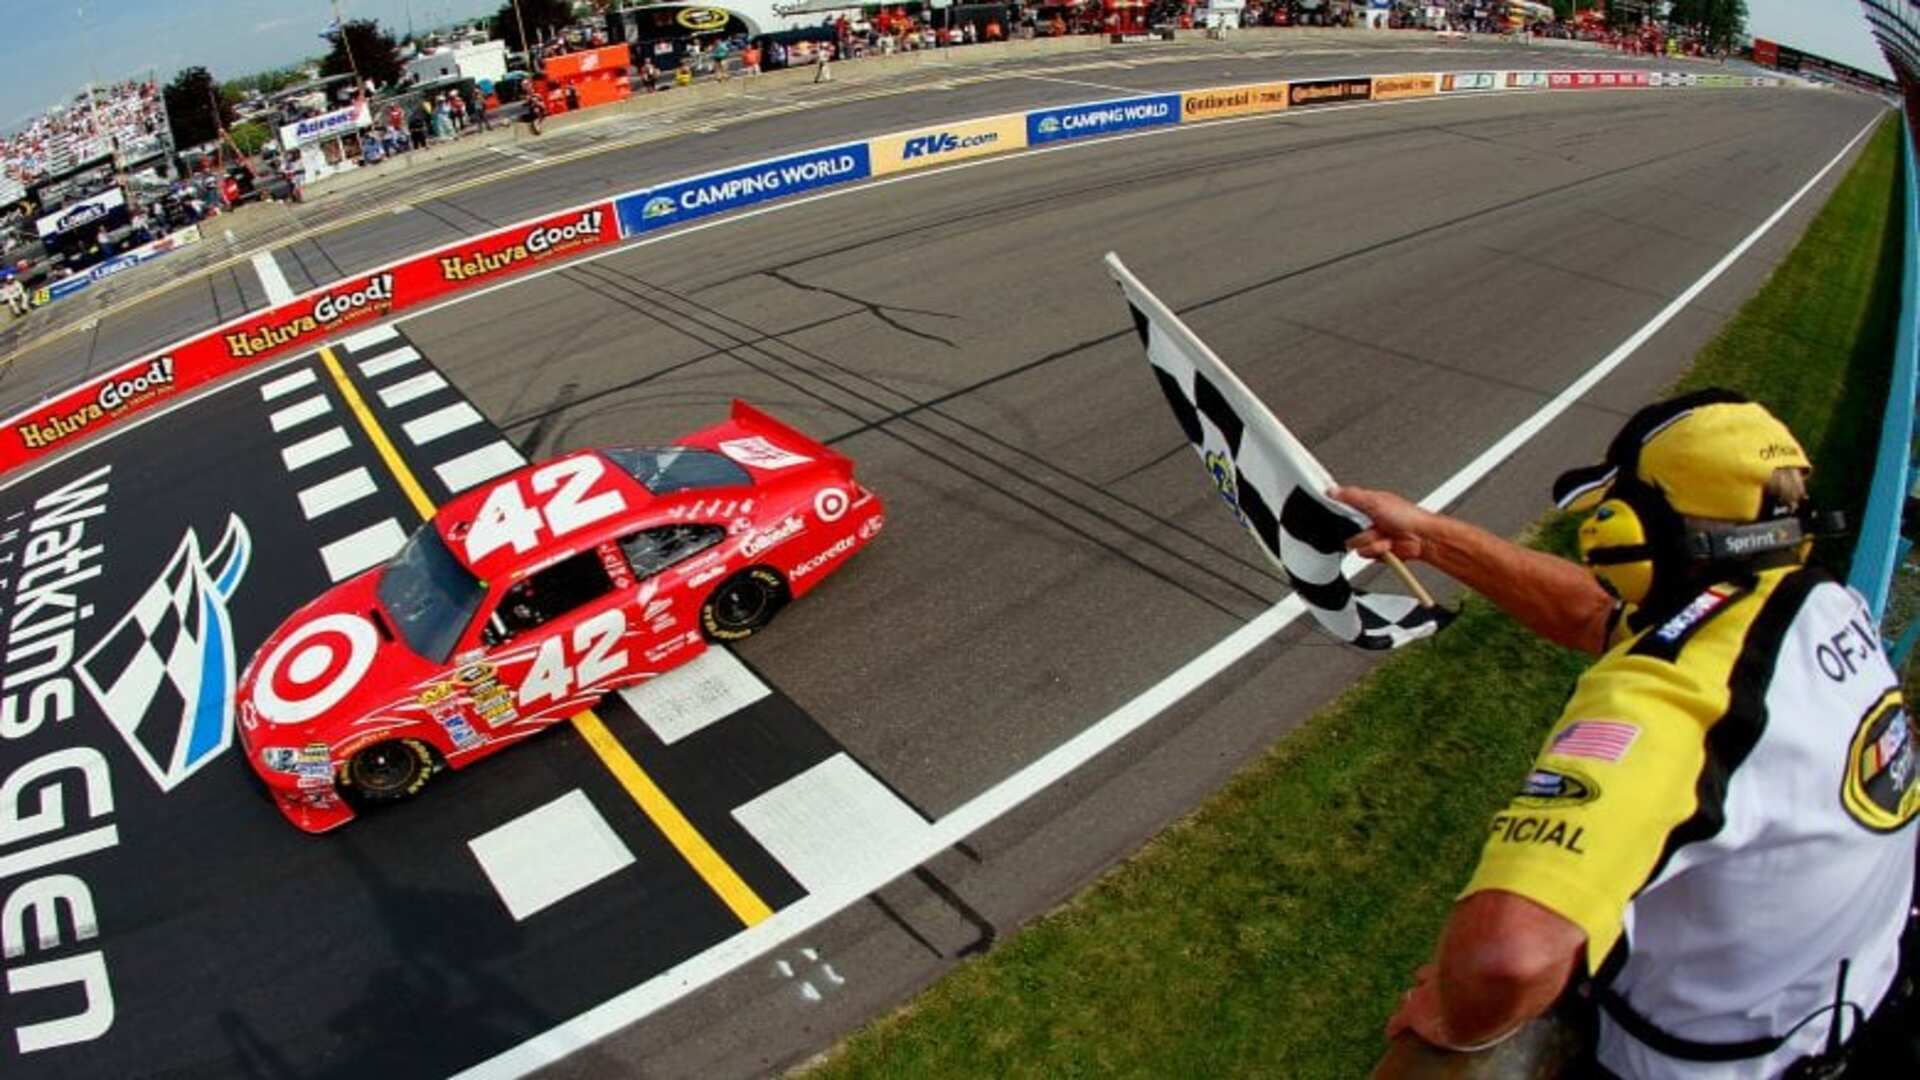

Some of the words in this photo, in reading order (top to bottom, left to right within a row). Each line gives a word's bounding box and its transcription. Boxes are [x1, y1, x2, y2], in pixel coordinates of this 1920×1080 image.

[1062, 107, 1123, 130] CAMPING
[1124, 103, 1169, 120] WORLD
[902, 132, 999, 161] RVs.com
[680, 170, 779, 210] CAMPING
[780, 154, 856, 186] WORLD
[464, 454, 628, 567] 42
[788, 534, 857, 581] Nicorette
[1724, 532, 1777, 553] Sprint
[0, 464, 112, 741] Watkins
[518, 607, 630, 708] 42
[0, 745, 120, 1055] Glen
